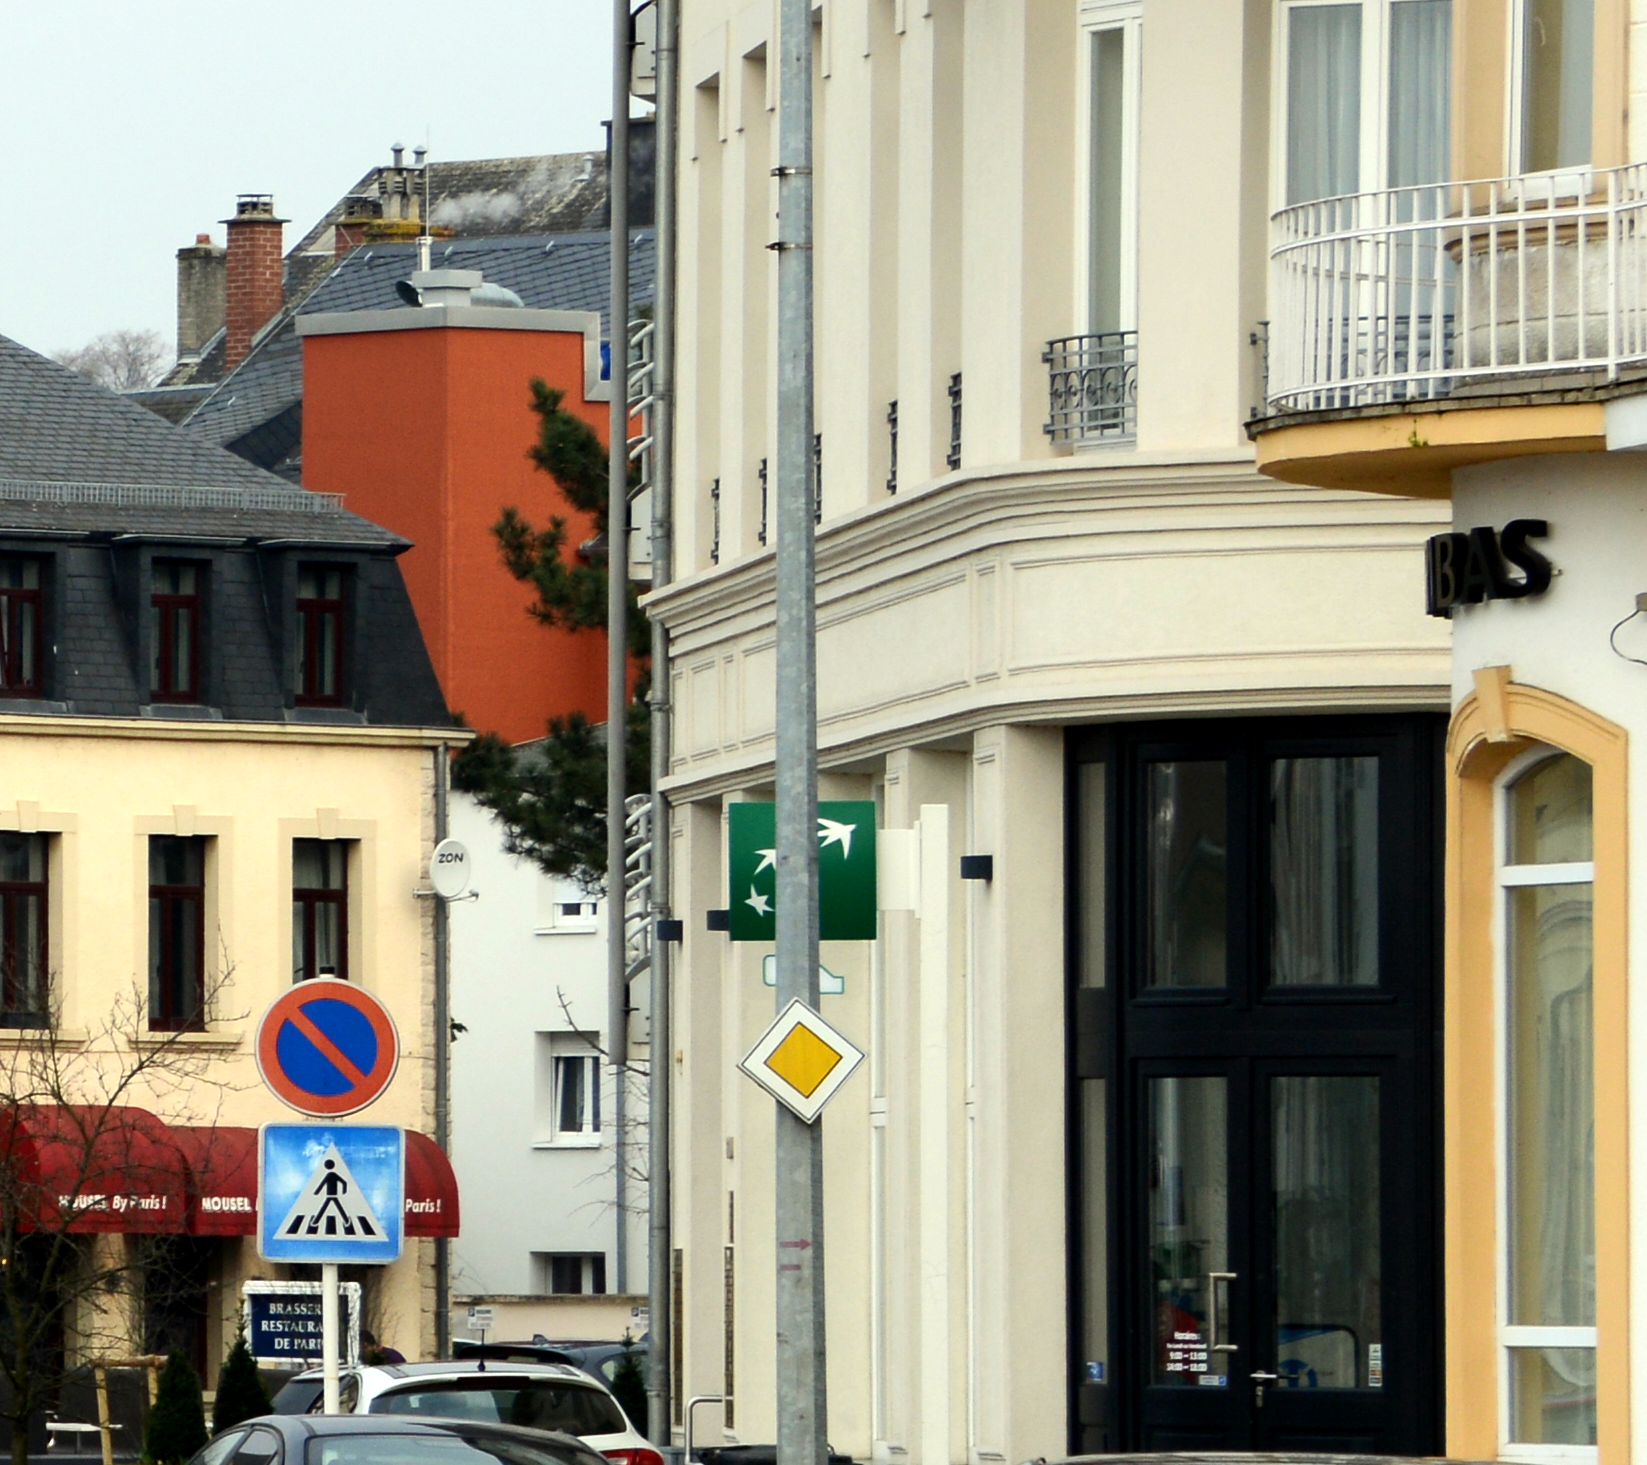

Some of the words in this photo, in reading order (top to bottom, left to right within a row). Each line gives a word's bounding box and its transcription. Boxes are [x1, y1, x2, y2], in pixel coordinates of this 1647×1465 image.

[1426, 519, 1553, 618] BAS
[111, 1196, 128, 1212] By
[201, 1197, 253, 1213] MOUSEL
[268, 1302, 322, 1315] BRASSER
[260, 1320, 323, 1333] RESTAURA
[274, 1337, 291, 1350] DE
[293, 1337, 323, 1350] PARI
